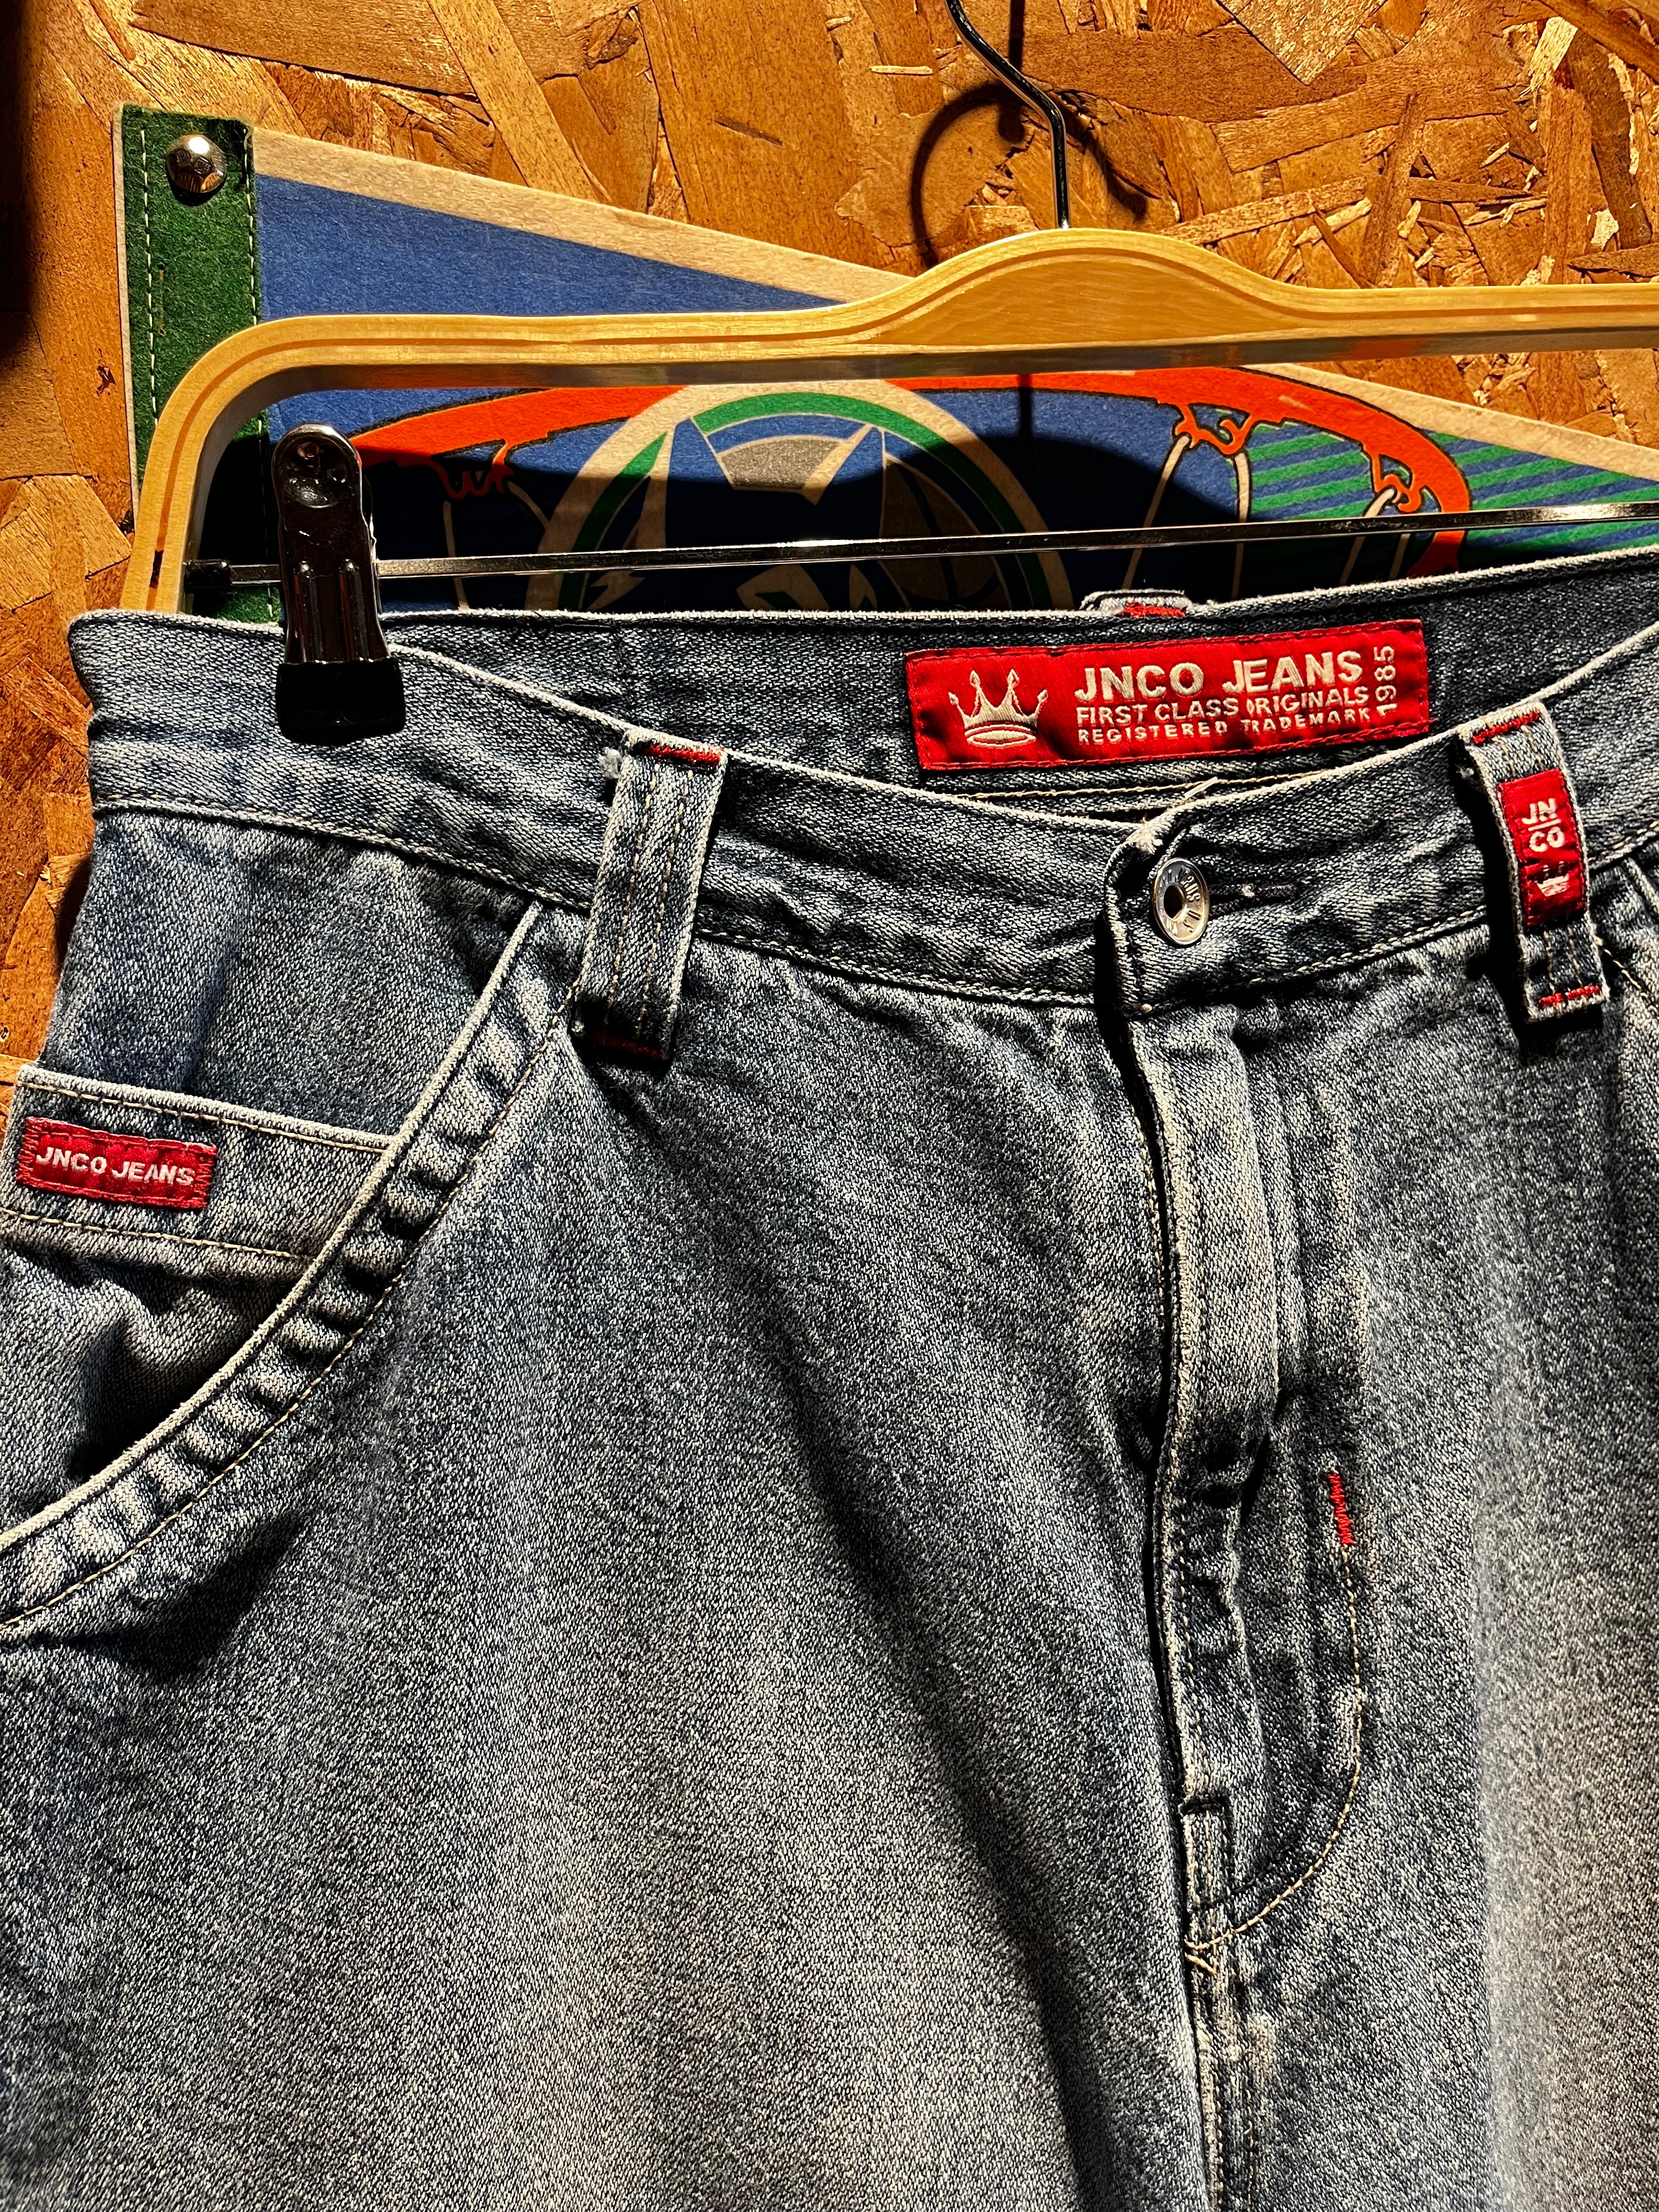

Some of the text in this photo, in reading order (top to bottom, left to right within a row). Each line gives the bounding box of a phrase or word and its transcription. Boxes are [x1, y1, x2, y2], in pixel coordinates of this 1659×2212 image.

[1074, 650, 1363, 702] JNCO JEANS
[1373, 646, 1397, 716] 1985
[1075, 704, 1148, 727] FIRST
[1154, 697, 1240, 721] CLASS
[1077, 707, 1370, 745] REGISTERED TRADEMARK
[1521, 798, 1558, 825] JN
[1529, 826, 1565, 853] CO
[35, 1146, 196, 1187] JNCO JEANS
